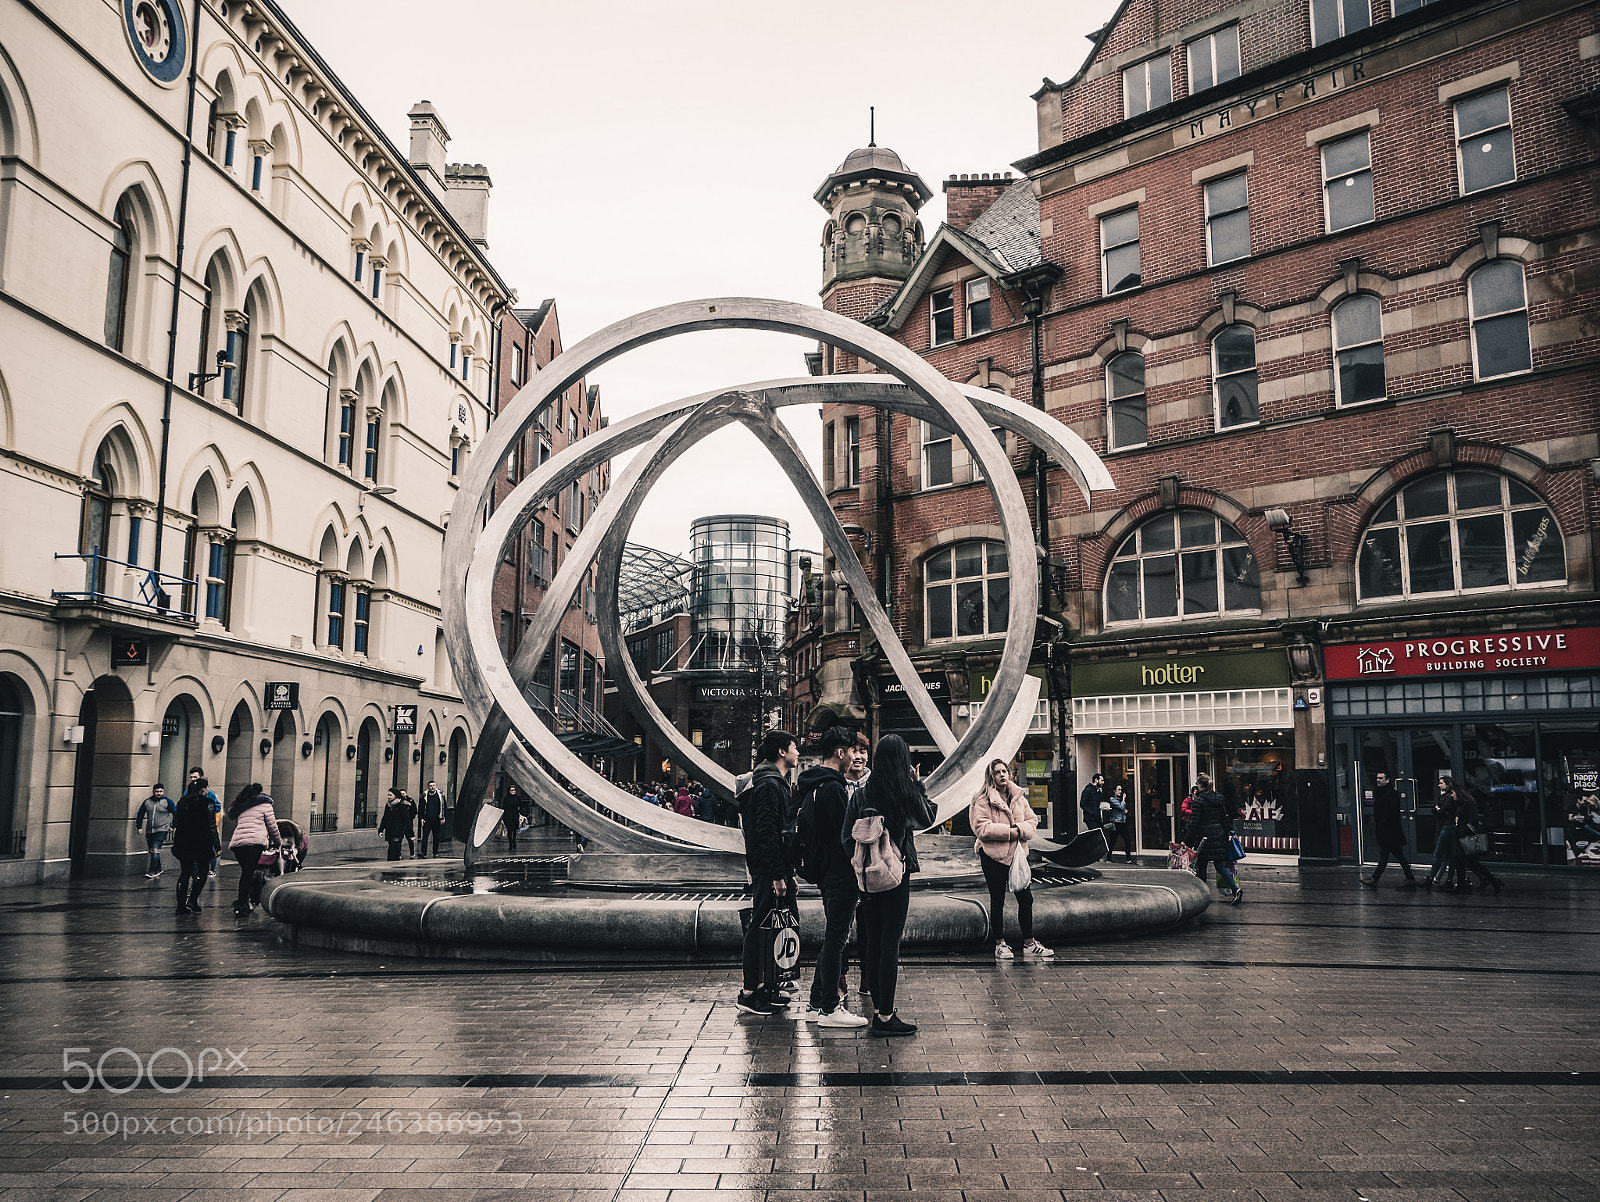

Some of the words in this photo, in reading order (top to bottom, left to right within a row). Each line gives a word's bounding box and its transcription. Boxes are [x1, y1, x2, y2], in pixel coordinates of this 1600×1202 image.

[1190, 62, 1366, 138] MAYFAIR
[1405, 633, 1567, 658] PROGRESSIVE
[1426, 659, 1485, 671] BUILDING
[1495, 656, 1547, 668] SOCIETY
[1141, 663, 1205, 686] hotter
[701, 687, 746, 697] VICTORIA
[1573, 773, 1598, 782] happy
[1574, 780, 1597, 789] place
[1237, 807, 1277, 821] SALE
[777, 937, 797, 961] JD
